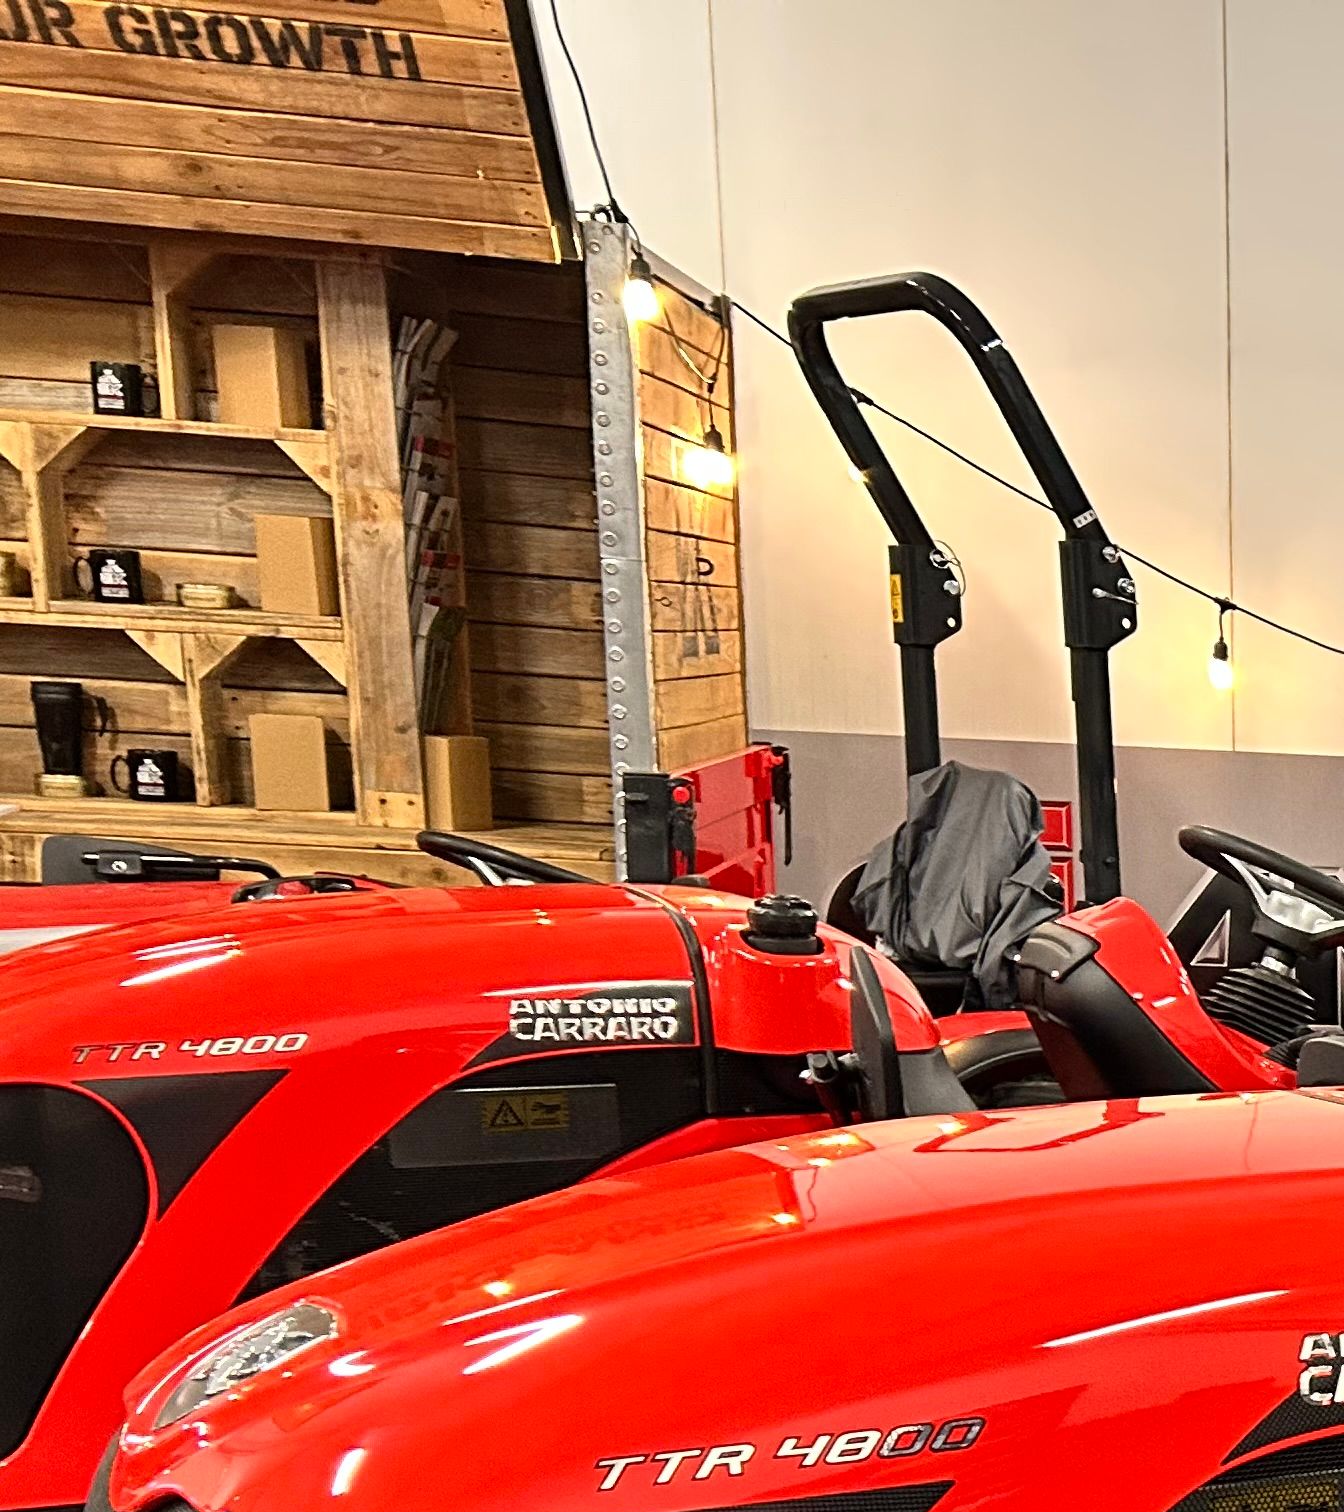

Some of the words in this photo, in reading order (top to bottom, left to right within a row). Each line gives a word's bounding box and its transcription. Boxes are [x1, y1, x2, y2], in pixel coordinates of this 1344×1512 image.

[103, 5, 422, 81] GROWTH
[509, 997, 677, 1015] ANTONIO
[509, 1016, 678, 1041] CARRARO
[72, 1040, 168, 1064] TTR
[178, 1032, 310, 1057] 4800
[594, 1443, 757, 1492] TTR
[774, 1416, 986, 1468] 4800
